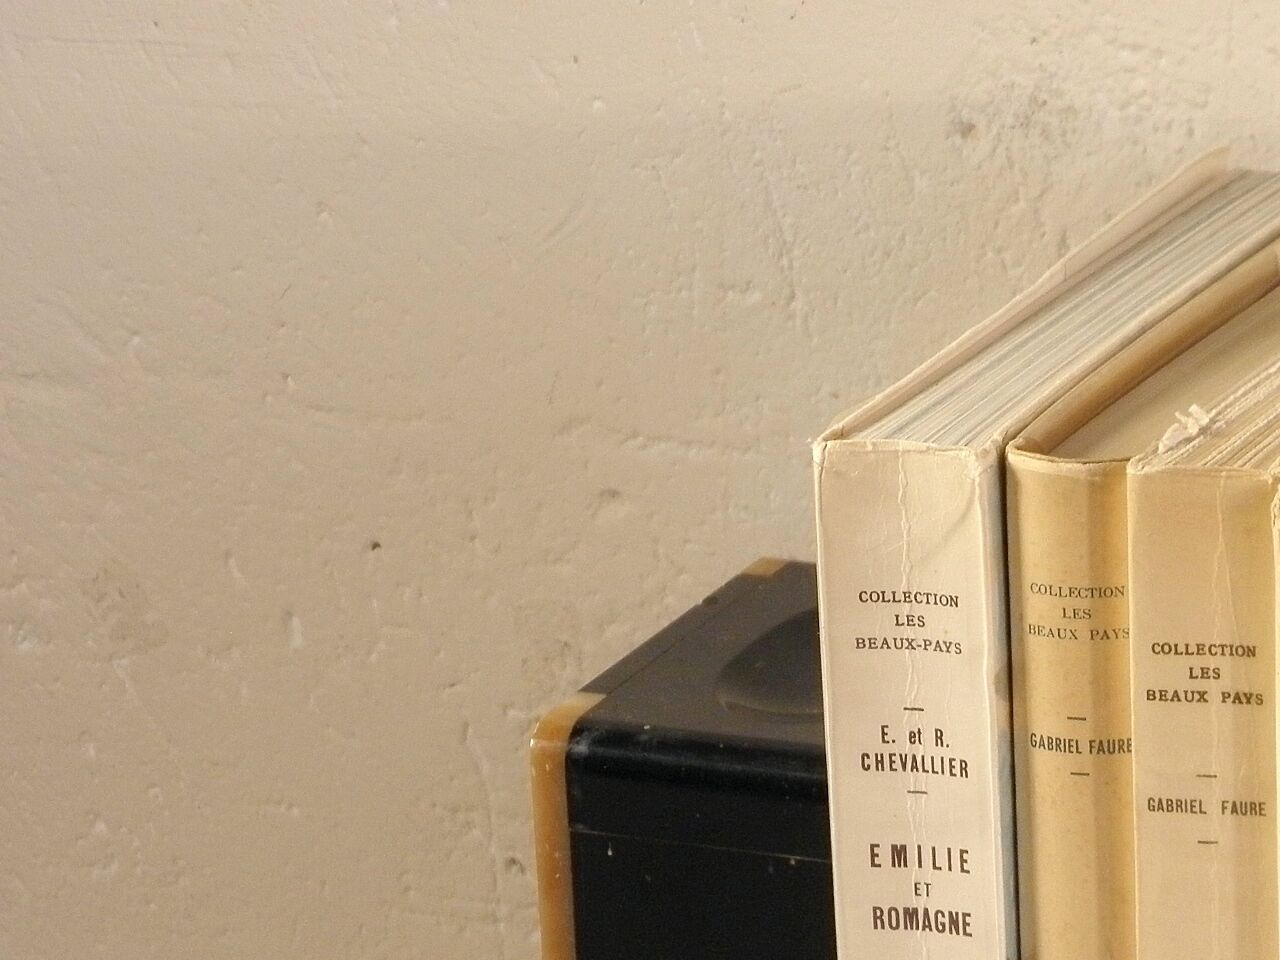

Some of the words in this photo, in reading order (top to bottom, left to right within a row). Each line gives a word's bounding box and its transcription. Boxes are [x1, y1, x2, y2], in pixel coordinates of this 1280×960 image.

[858, 590, 960, 609] COLLECTION
[1030, 582, 1126, 600] COLLECTION
[894, 614, 927, 628] LES
[1062, 607, 1093, 621] LES
[1028, 623, 1079, 642] BEAUX
[1089, 627, 1130, 642] PAYS
[855, 636, 963, 655] BEAUX-PAYS
[1151, 642, 1258, 659] COLLECTION
[1188, 666, 1222, 681] LES
[1146, 688, 1209, 704] BEAUX
[1221, 690, 1265, 706] PAYS
[880, 725, 896, 744] E.
[908, 728, 923, 746] et
[934, 728, 950, 749] R.
[1030, 732, 1082, 755] GABRIEL
[1088, 737, 1133, 756] FAURE
[860, 752, 970, 779] CHEVALLIER
[1147, 796, 1208, 816] GABRIEL
[1221, 800, 1268, 818] FAURE
[869, 843, 972, 875] EMILIE
[914, 881, 933, 898] ET
[872, 905, 973, 938] ROMAGNE
